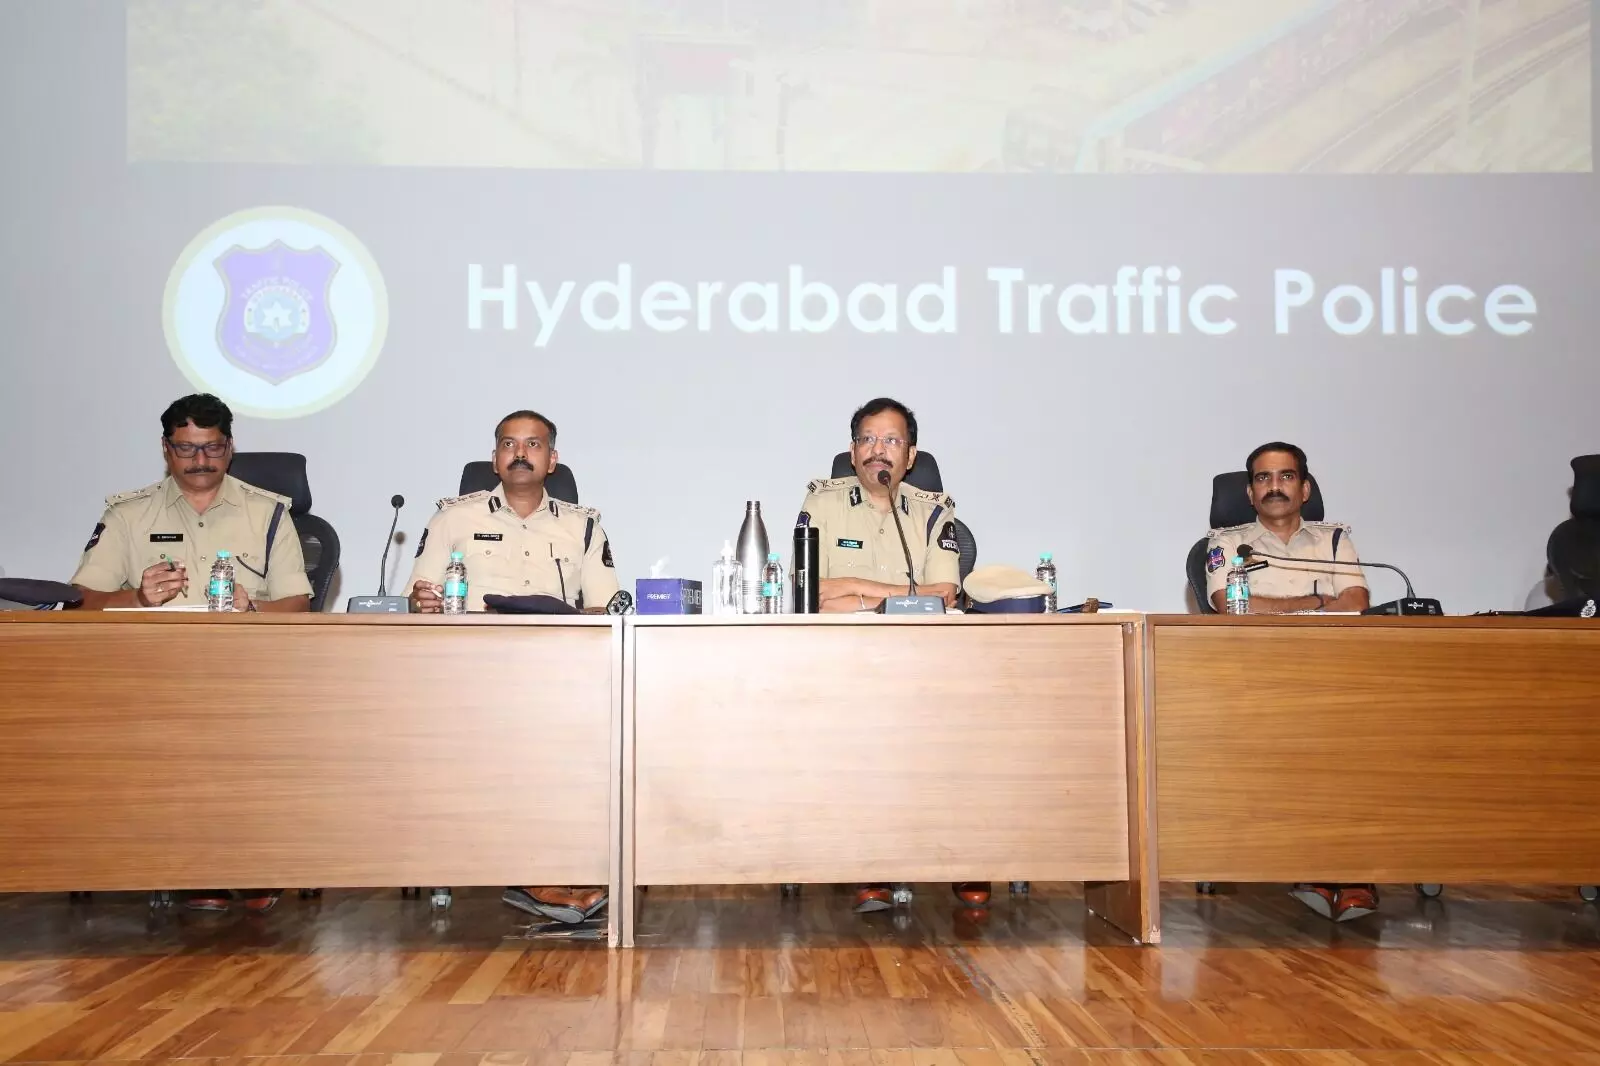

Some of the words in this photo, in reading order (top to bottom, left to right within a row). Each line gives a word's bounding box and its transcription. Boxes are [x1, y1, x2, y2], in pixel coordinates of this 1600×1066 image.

[467, 262, 957, 347] Hyderabad
[987, 265, 1239, 335] Traffic
[1274, 266, 1538, 336] Police
